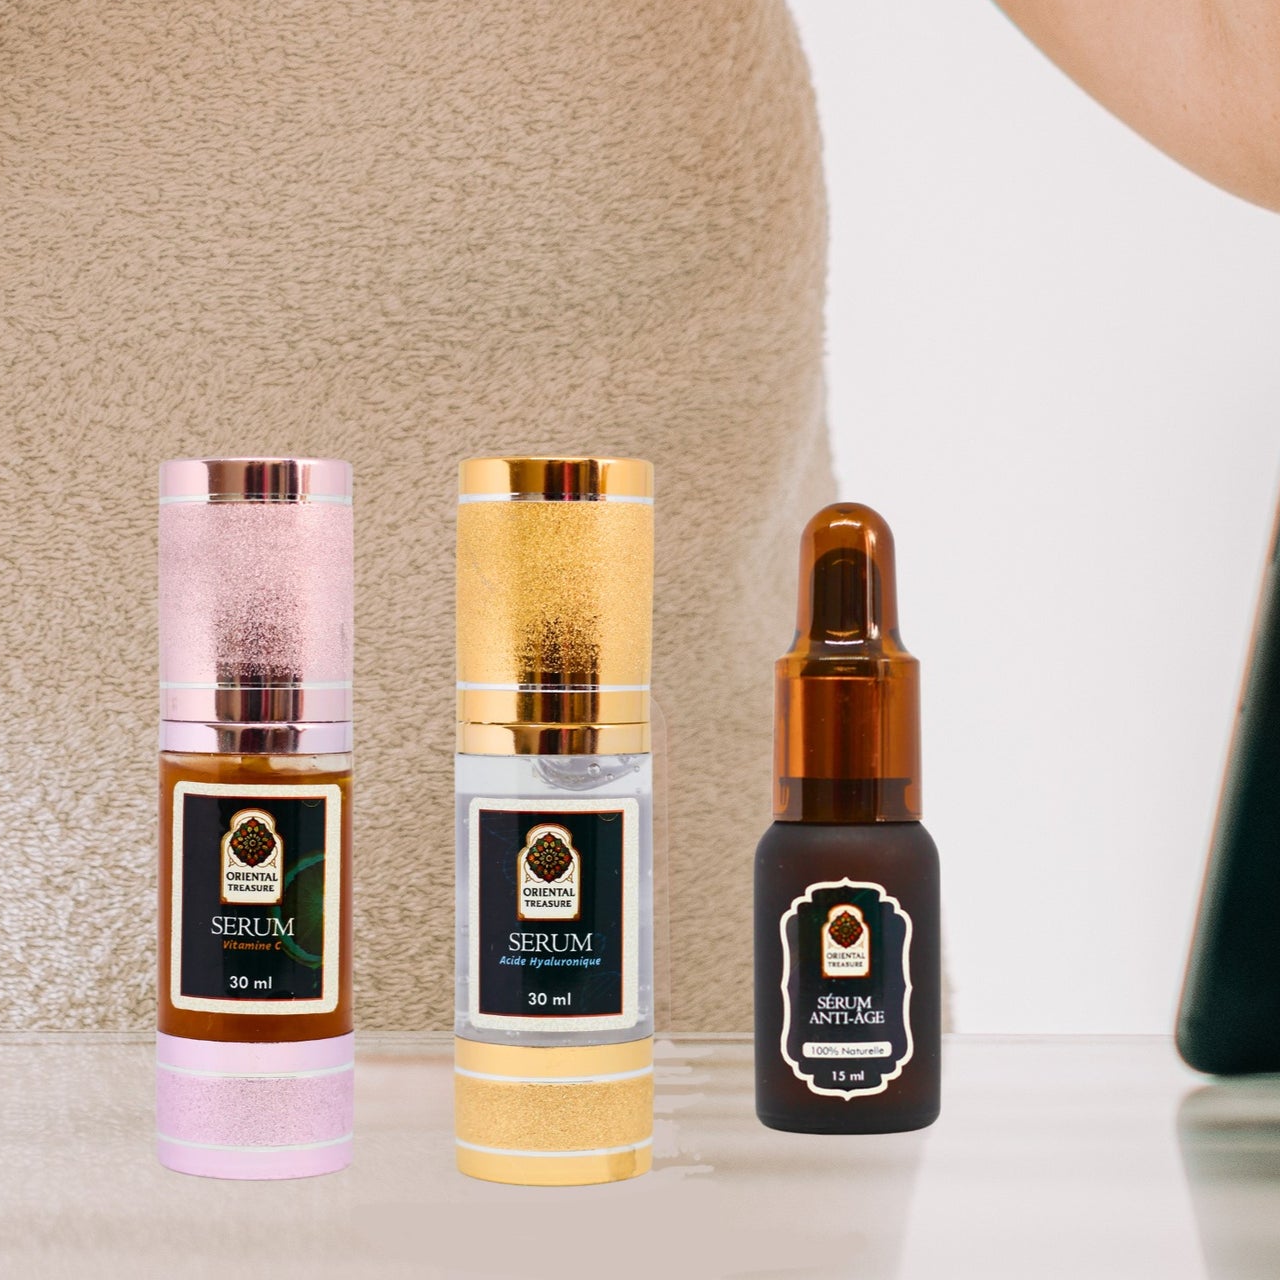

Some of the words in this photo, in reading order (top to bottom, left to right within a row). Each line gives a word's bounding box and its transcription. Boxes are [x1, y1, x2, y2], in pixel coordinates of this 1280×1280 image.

[226, 872, 278, 881] ORIENTAL
[228, 883, 274, 892] TREASURE
[523, 887, 575, 897] ORIENTAL
[524, 900, 572, 908] TREASURE
[210, 916, 295, 937] SERUM
[223, 940, 272, 951] Vitamine
[274, 941, 281, 951] C
[508, 932, 593, 953] SERUM
[499, 955, 527, 966] Acide
[529, 956, 601, 968] Hyaluronique
[229, 975, 249, 989] 30
[254, 976, 273, 989] ml
[528, 992, 548, 1006] 30
[552, 992, 571, 1006] ml
[817, 993, 871, 1009] SÉRUM
[809, 1006, 885, 1025] ANTI-ÂGE
[810, 1045, 839, 1056] 100%
[841, 1045, 885, 1056] Naturelle
[831, 1070, 846, 1082] 15
[850, 1070, 865, 1082] ml
